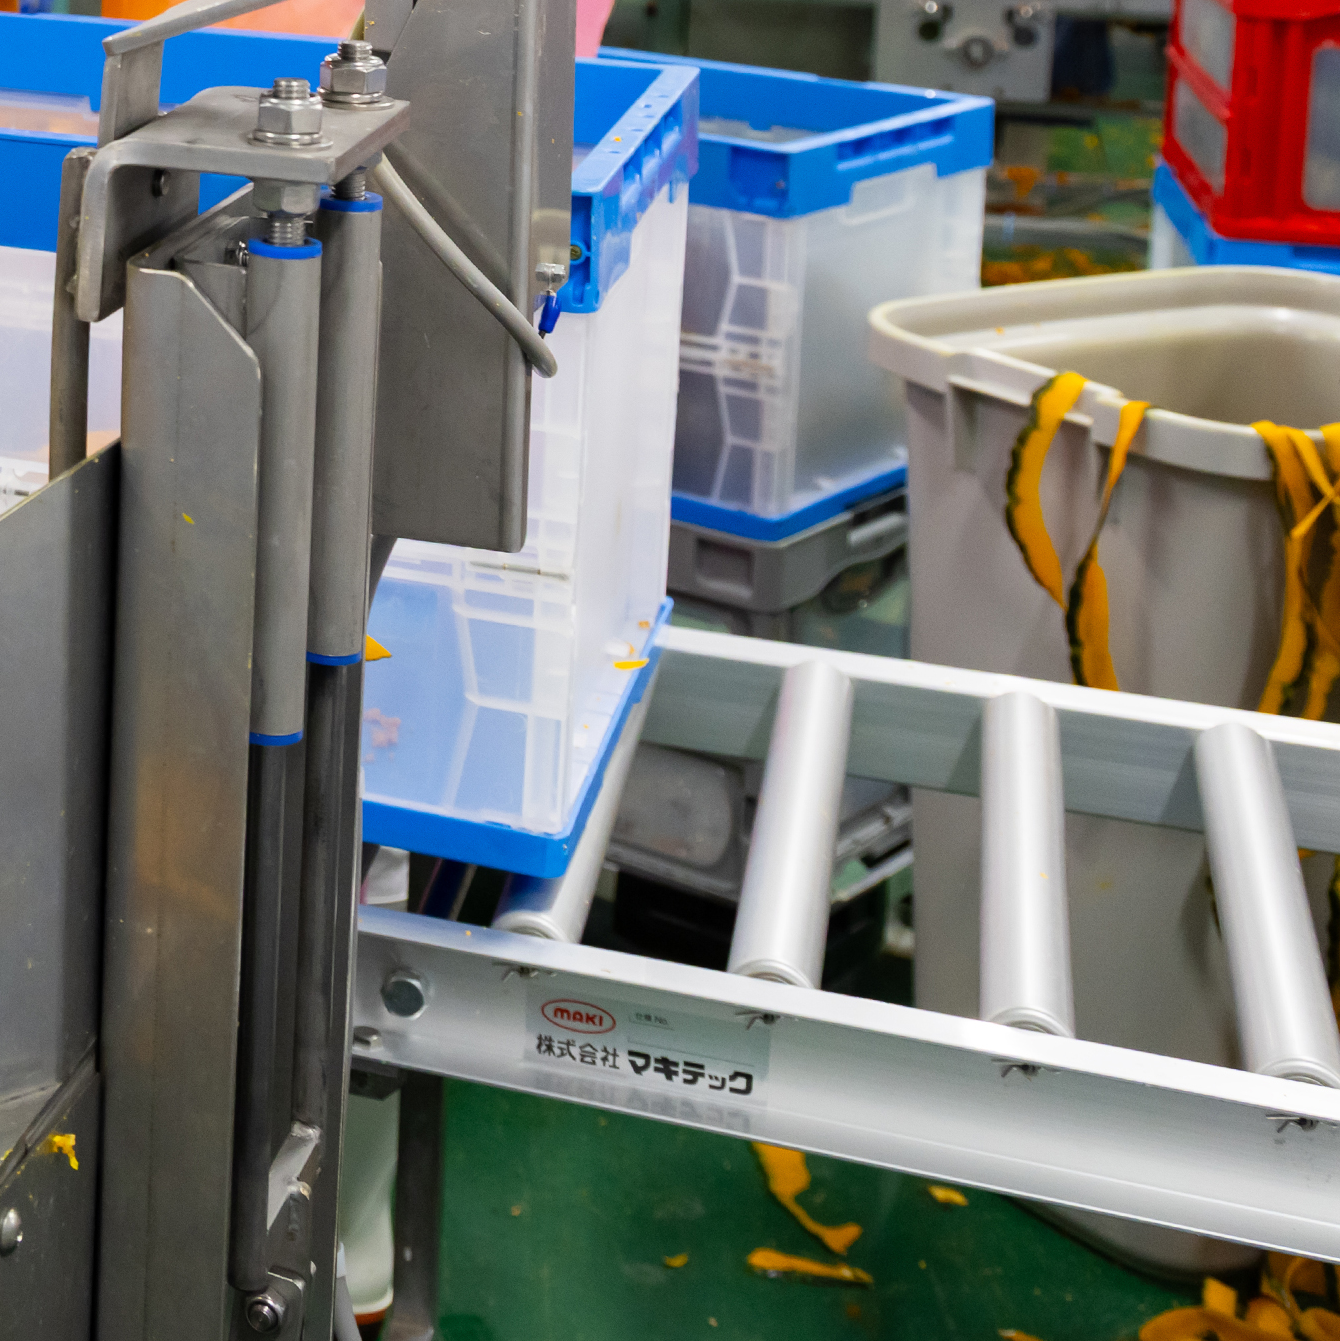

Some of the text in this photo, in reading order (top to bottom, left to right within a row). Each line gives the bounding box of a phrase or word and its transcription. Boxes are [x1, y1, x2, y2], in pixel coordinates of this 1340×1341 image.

[553, 1006, 604, 1027] MAKI
[535, 1033, 754, 1096] 株式会社 マキテック
